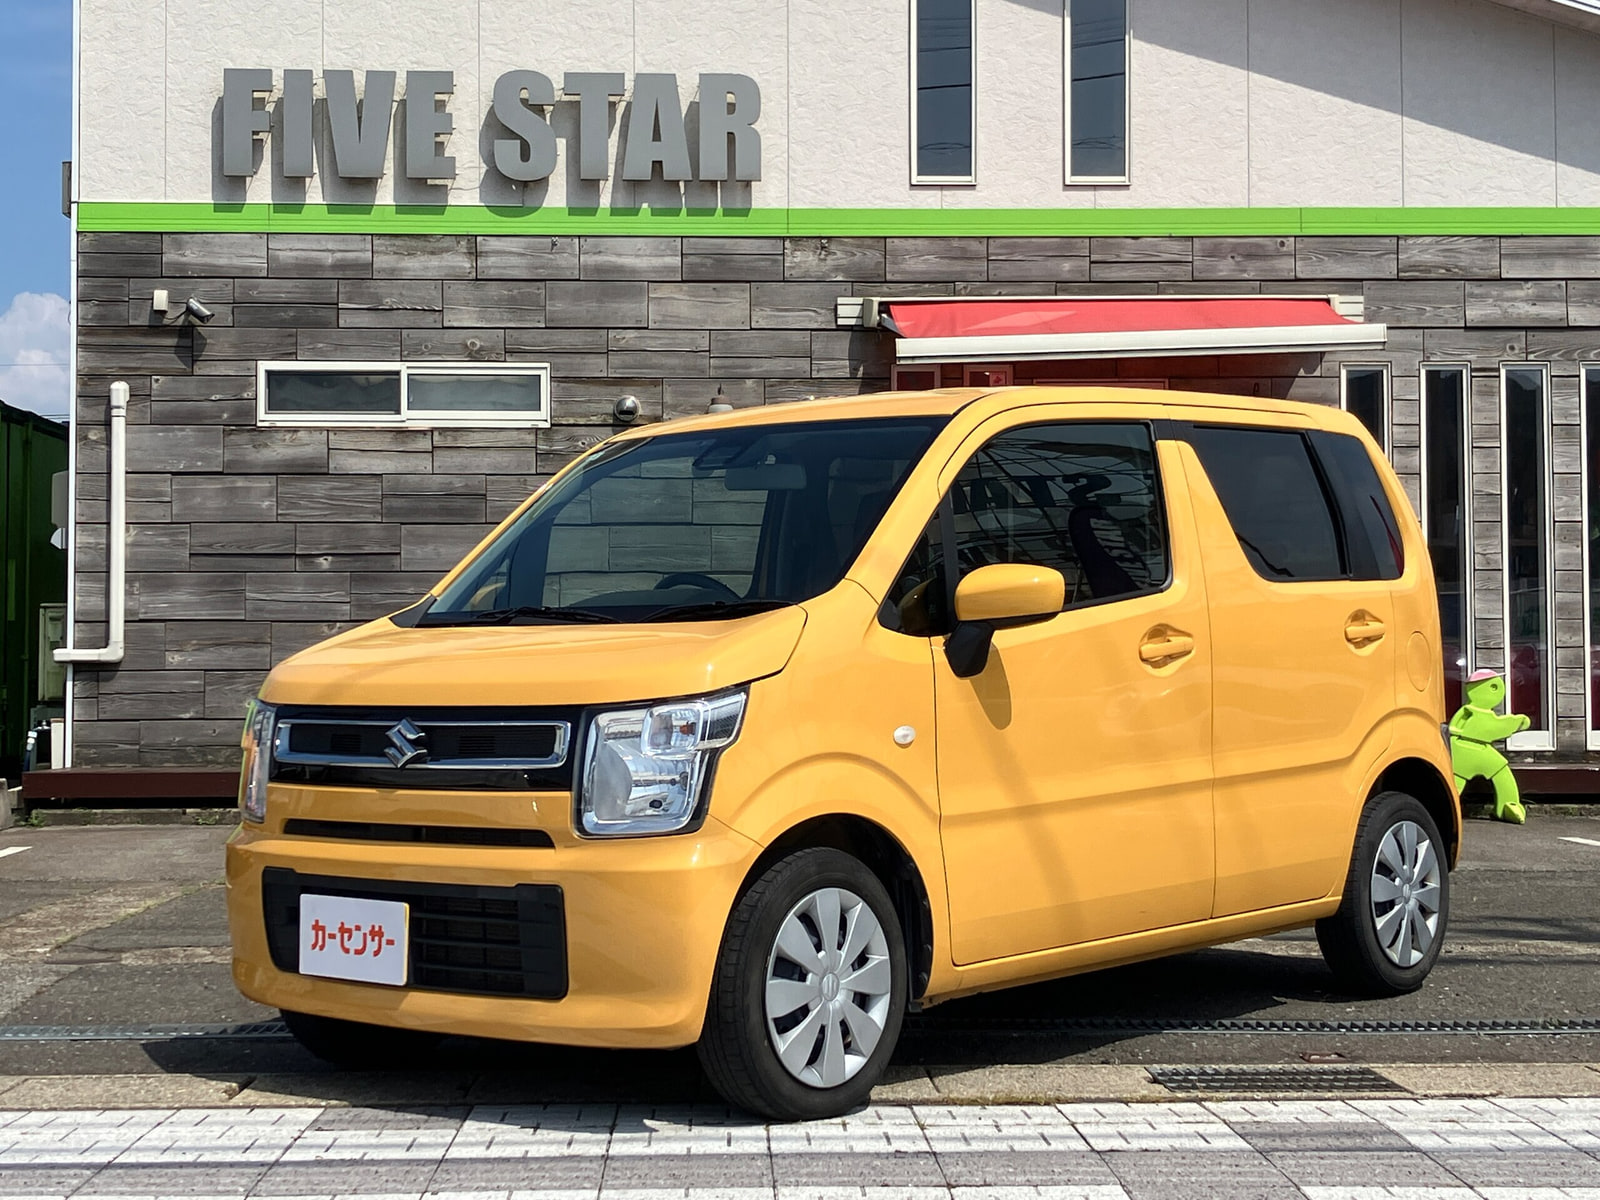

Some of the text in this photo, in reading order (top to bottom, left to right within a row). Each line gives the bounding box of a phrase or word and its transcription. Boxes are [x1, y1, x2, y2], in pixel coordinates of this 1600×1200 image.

[223, 68, 761, 181] FIVE STAR
[311, 919, 395, 957] カーセンサー
